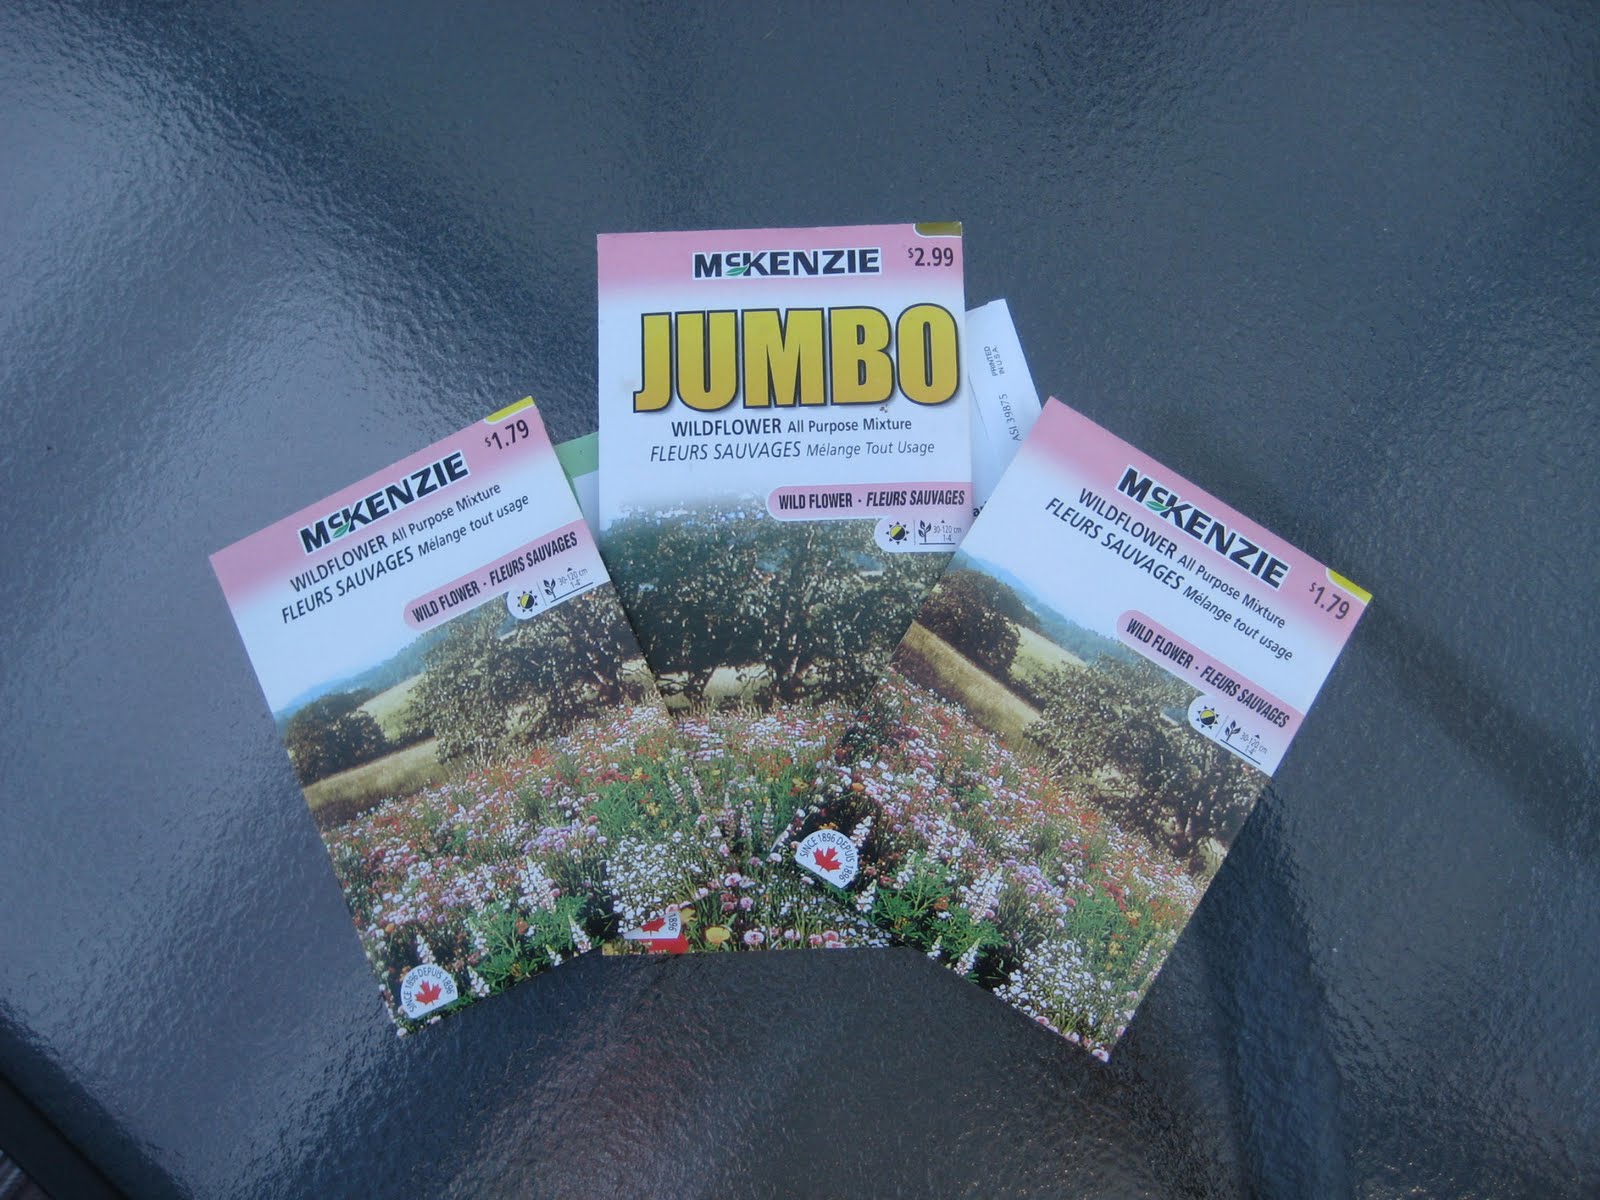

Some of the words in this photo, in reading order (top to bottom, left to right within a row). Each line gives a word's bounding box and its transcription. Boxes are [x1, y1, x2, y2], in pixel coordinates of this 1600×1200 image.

[908, 246, 954, 268] $2.99
[633, 302, 961, 413] JUMBO
[984, 346, 998, 377] PRINTED
[998, 393, 1015, 424] 39875
[485, 419, 530, 451] $1.79
[671, 418, 782, 438] WILDFLOWER
[788, 419, 804, 433] All
[808, 418, 859, 436] Purpose
[863, 417, 912, 431] Mixture
[1009, 426, 1022, 442] ASI
[650, 443, 708, 462] FLEURS
[713, 441, 801, 461] SAUVAGES
[806, 442, 861, 459] Mélange
[866, 441, 894, 456] Tout
[898, 440, 935, 457] Usage
[778, 494, 807, 510] WILD
[809, 492, 853, 509] FLOWER
[866, 490, 907, 507] FLEURS
[909, 489, 965, 506] SAUVAGES
[290, 535, 388, 593] WILDFLOWER
[392, 524, 406, 544] All
[408, 506, 454, 536] Purpose
[456, 483, 501, 514] Mixture
[933, 525, 953, 534] 30-120
[282, 588, 333, 624] FLEURS
[336, 547, 414, 600] SAUVAGES
[418, 527, 467, 557] Mélange
[469, 512, 494, 533] tout
[496, 496, 529, 520] usage
[1079, 488, 1177, 558] WILDFLOWER
[1177, 554, 1196, 571] All
[1196, 565, 1240, 600] Purpose
[1242, 593, 1286, 629] Mixture
[412, 602, 438, 623] WILD
[438, 580, 480, 611] FLOWER
[489, 561, 526, 587] FLEURS
[526, 531, 578, 570] SAUVAGES
[558, 571, 579, 586] 30-120
[579, 568, 588, 577] cm
[1045, 497, 1101, 541] FLEURS
[1101, 532, 1185, 590] SAUVAGES
[1184, 586, 1232, 623] Mélange
[1234, 615, 1259, 641] tout
[1259, 636, 1293, 662] usage
[1309, 582, 1350, 621] $1.79
[1126, 618, 1153, 644] WILD
[1152, 633, 1193, 670] FLOWER
[1200, 665, 1240, 699] FLEURS
[1237, 688, 1291, 728] SAUVAGES
[800, 836, 818, 858] SINCE
[817, 832, 836, 843] 1896
[836, 836, 856, 863] DEPUIS
[838, 865, 854, 882] 1896
[668, 913, 678, 932] 1896
[405, 972, 418, 989] 1896
[417, 966, 443, 979] DEPUIS
[442, 976, 455, 994] 1896
[403, 990, 417, 1013] SINCE
